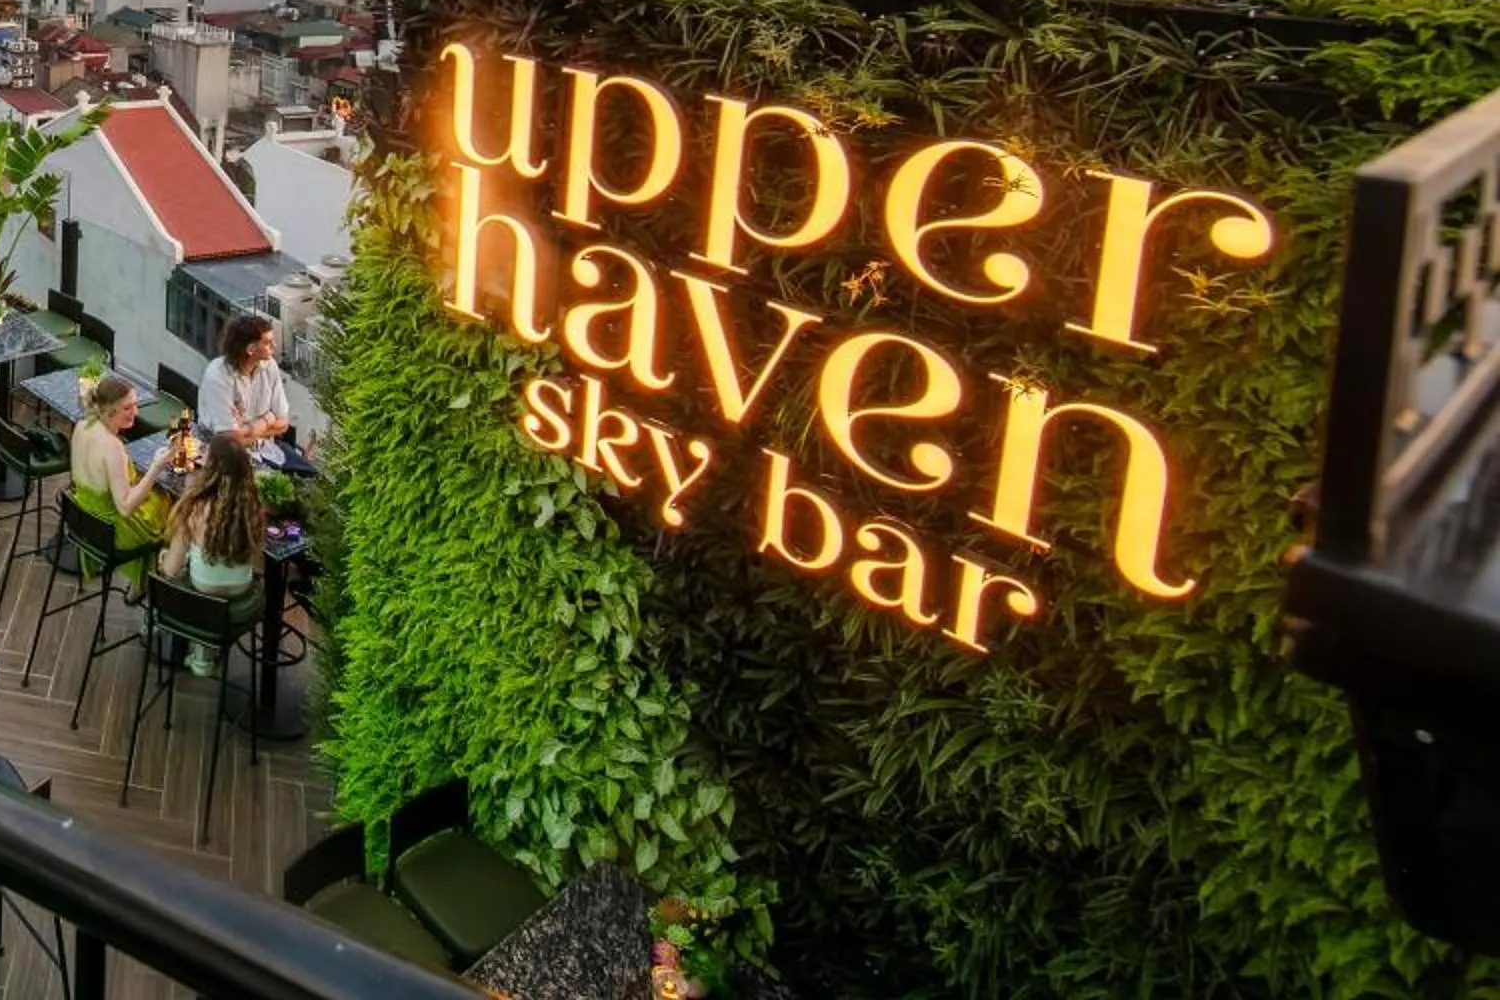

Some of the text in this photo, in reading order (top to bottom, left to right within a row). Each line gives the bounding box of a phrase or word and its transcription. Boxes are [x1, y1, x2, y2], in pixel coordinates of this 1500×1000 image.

[439, 41, 1274, 354] upper
[443, 161, 1197, 599] haven
[521, 374, 1041, 653] sky bar
